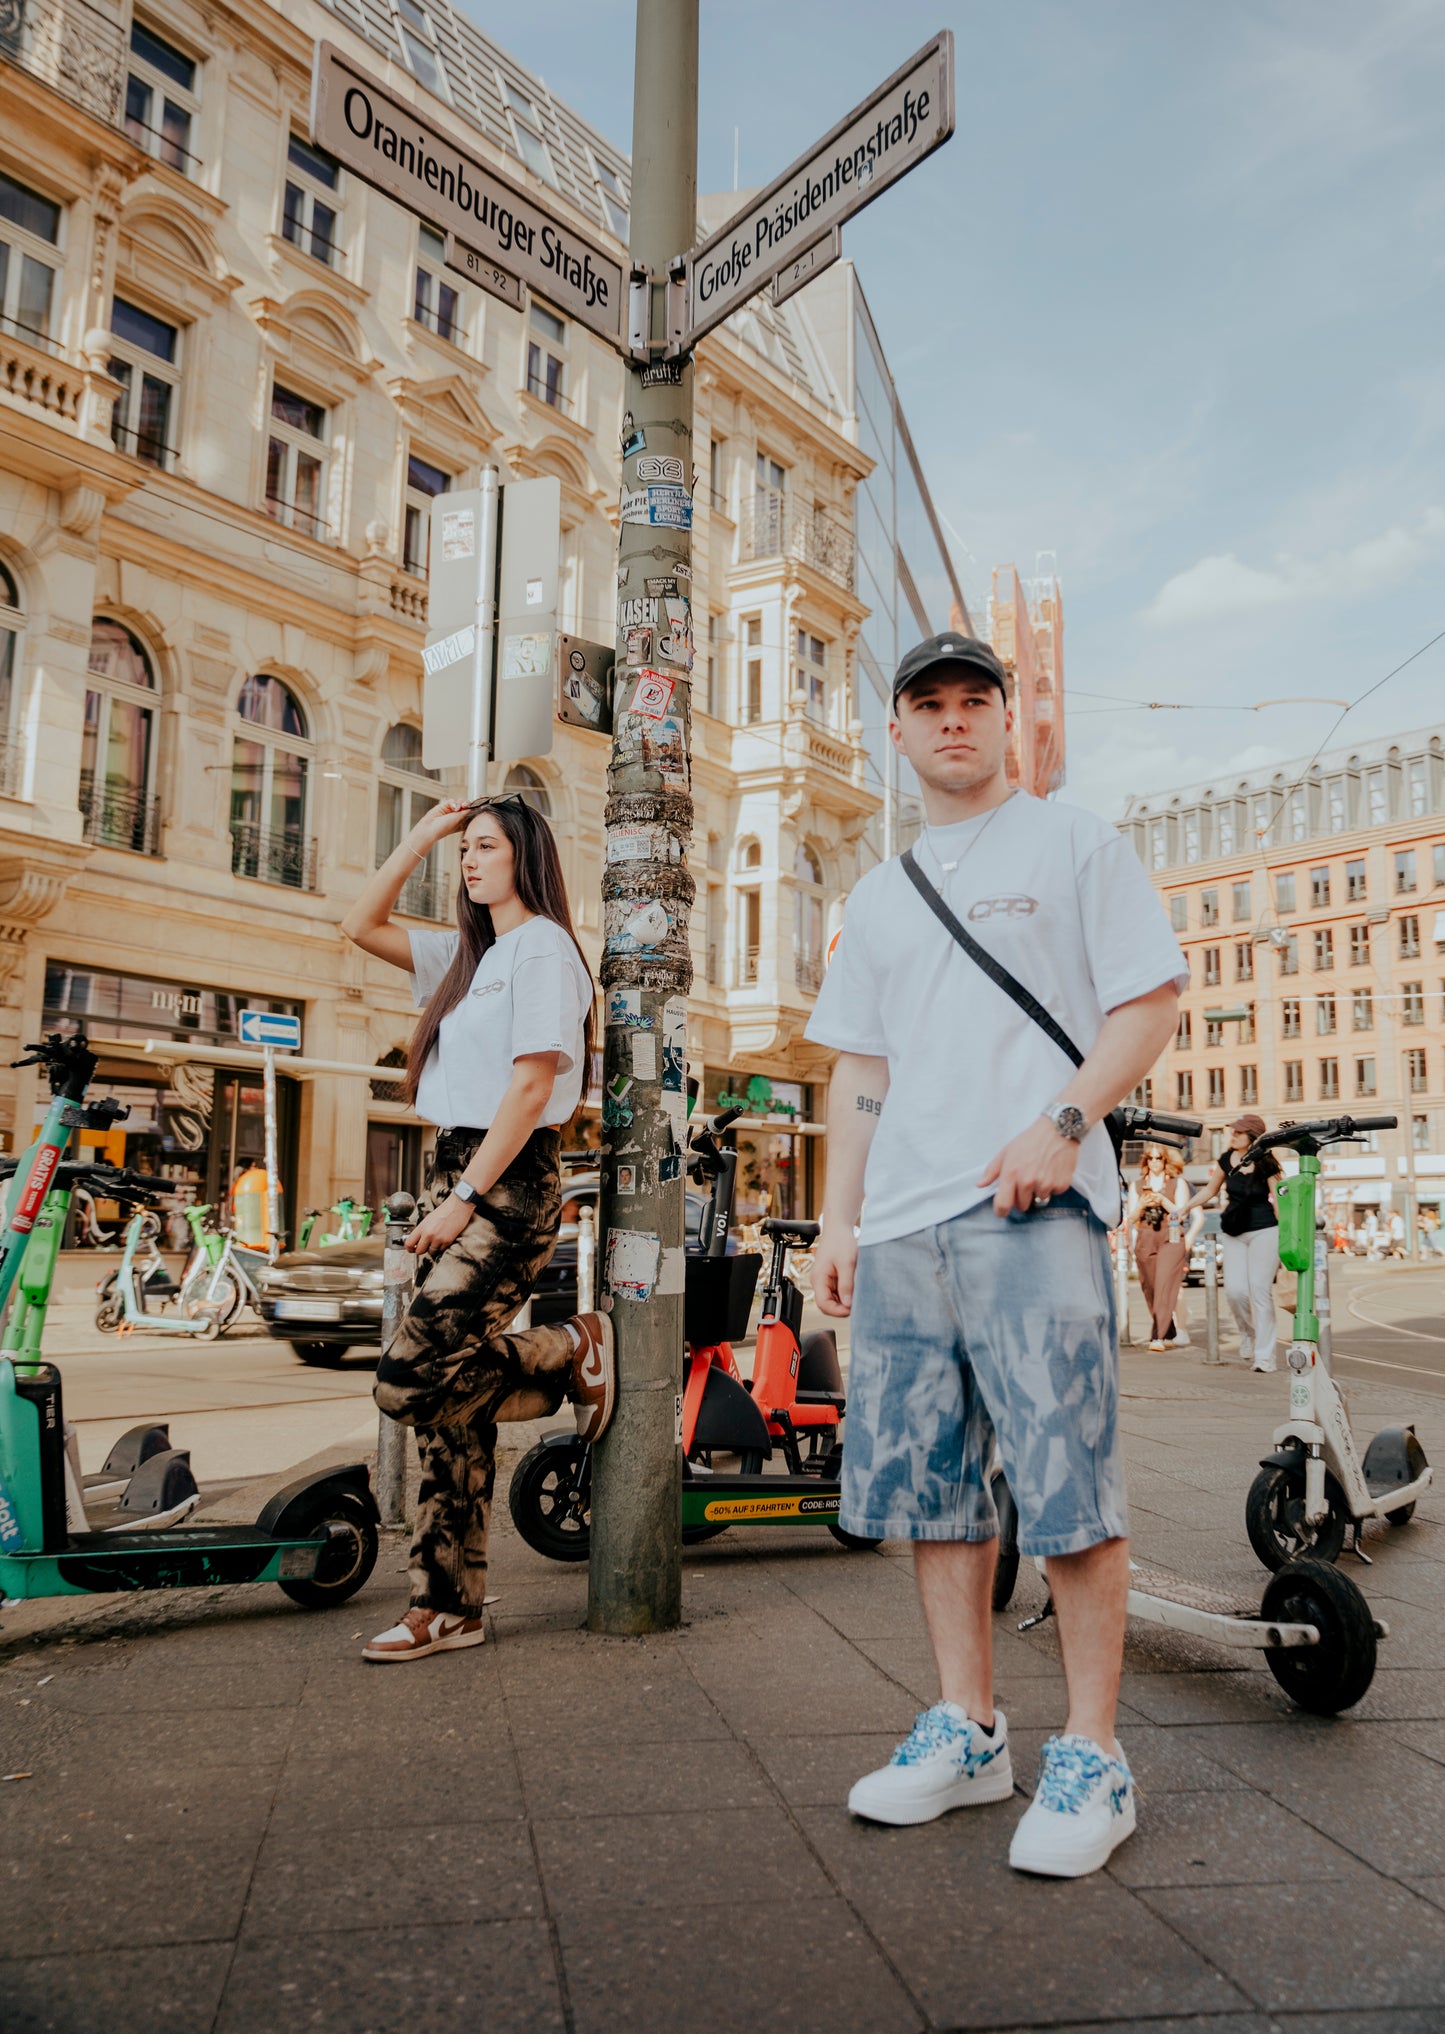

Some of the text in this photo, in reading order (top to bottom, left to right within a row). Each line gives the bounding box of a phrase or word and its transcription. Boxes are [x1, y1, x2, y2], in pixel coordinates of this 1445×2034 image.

[344, 87, 609, 308] Oranienburger Straße
[700, 89, 930, 301] Große Präsidentenstraße
[467, 254, 480, 273] 81
[493, 270, 507, 290] 92
[794, 263, 800, 280] 2
[31, 1149, 56, 1190] GRATIS
[45, 1393, 56, 1429] TIER
[732, 1505, 749, 1514] AUF
[802, 1500, 825, 1510] CODE:
